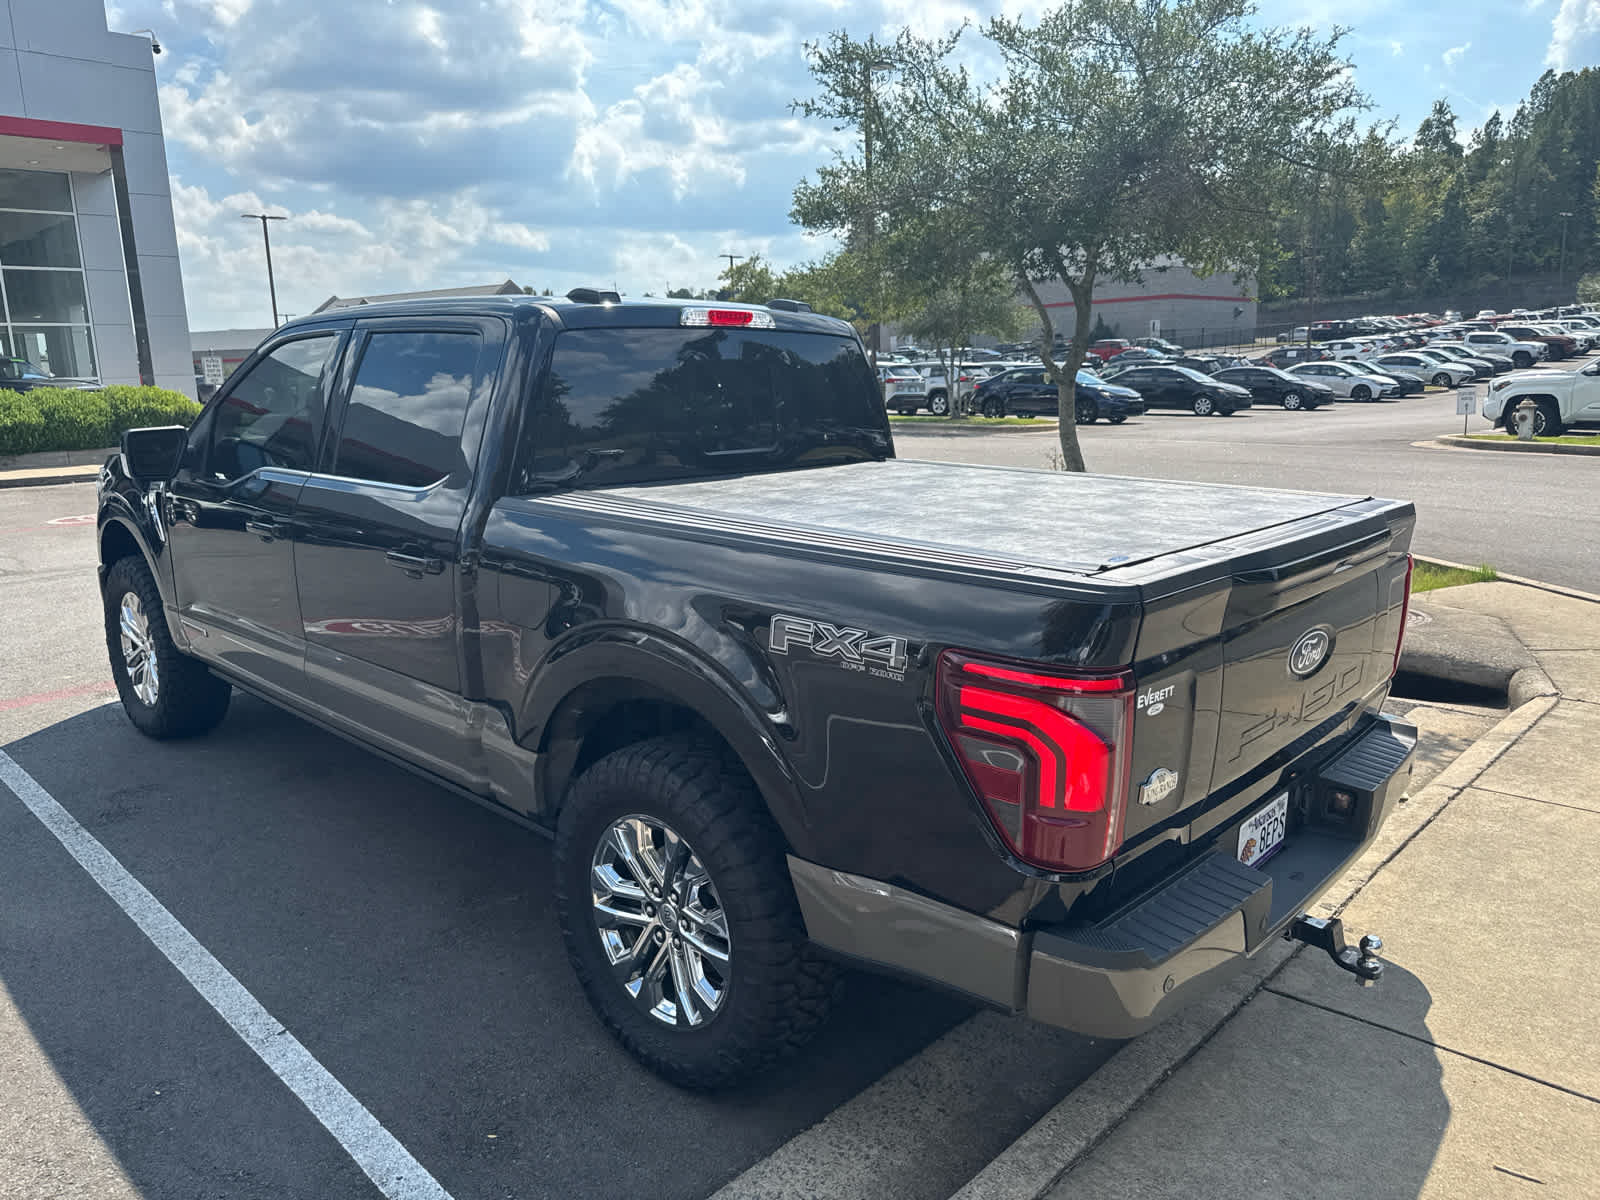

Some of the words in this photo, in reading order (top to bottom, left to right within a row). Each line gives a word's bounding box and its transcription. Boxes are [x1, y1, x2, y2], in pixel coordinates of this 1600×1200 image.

[769, 614, 908, 673] FX4
[1298, 638, 1324, 669] Ford
[1137, 685, 1175, 709] EVERETT
